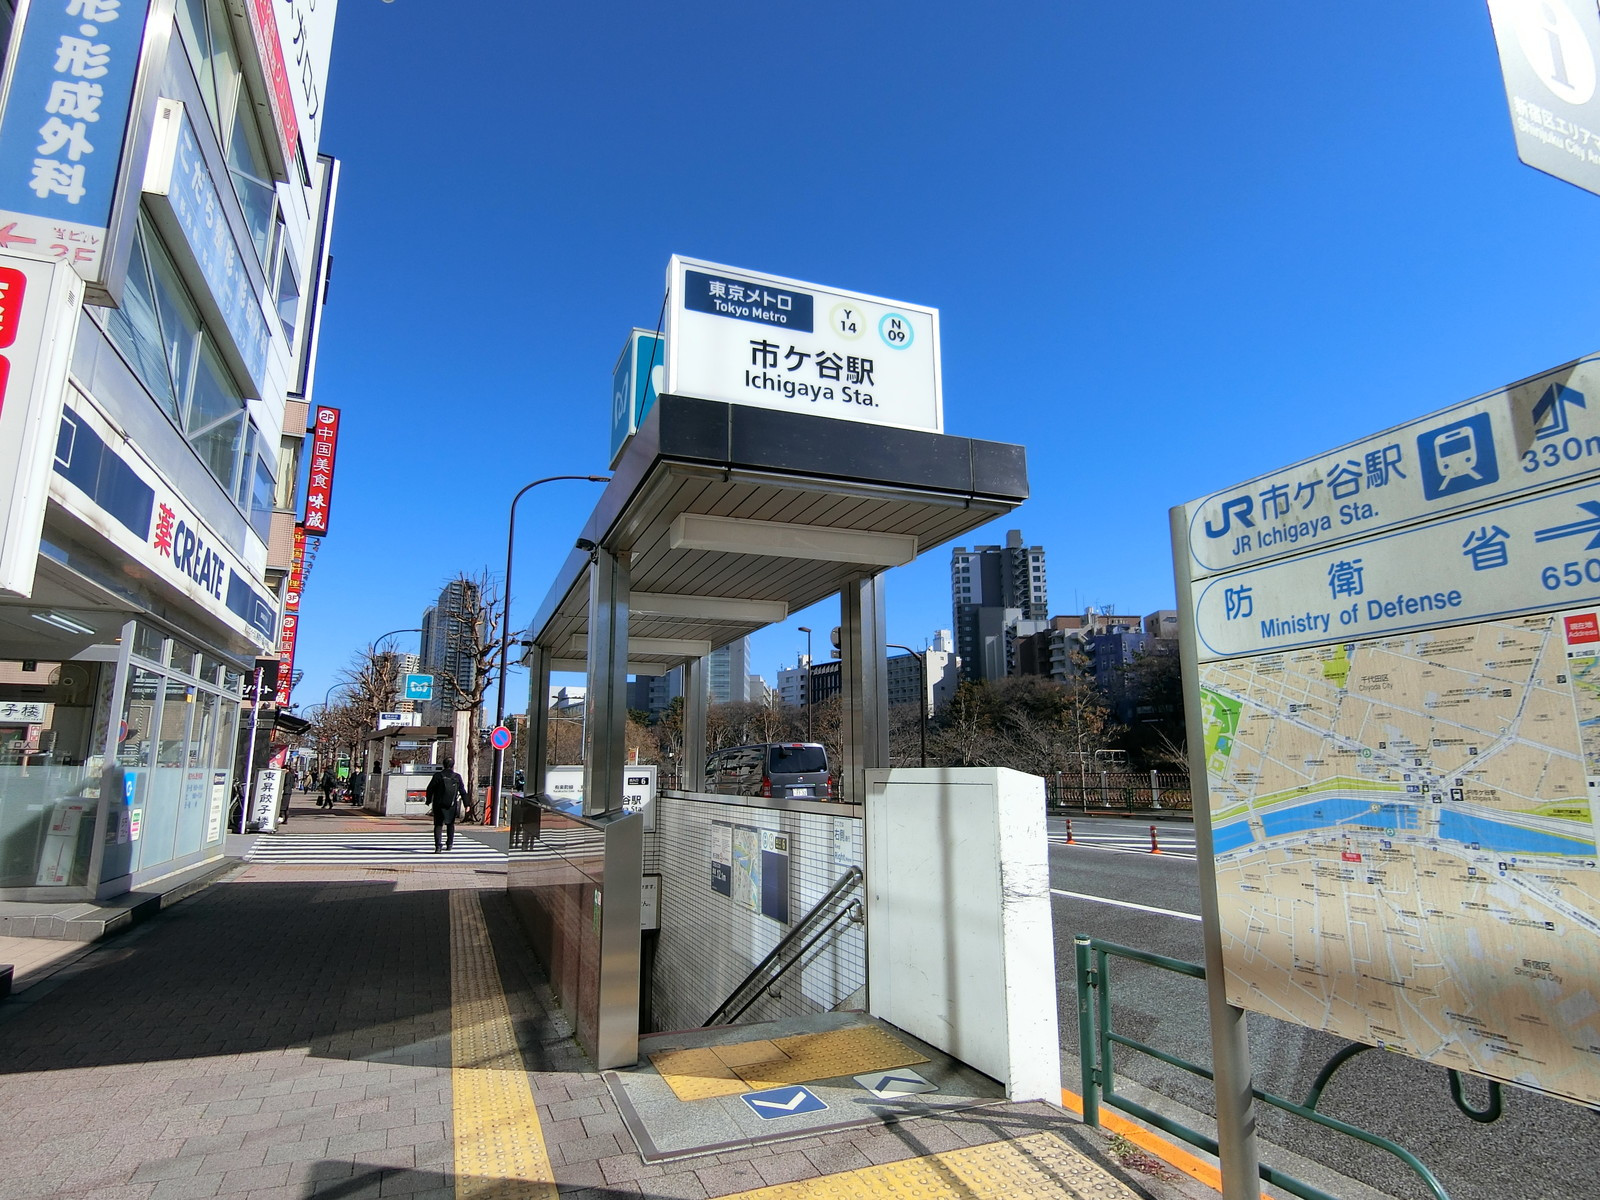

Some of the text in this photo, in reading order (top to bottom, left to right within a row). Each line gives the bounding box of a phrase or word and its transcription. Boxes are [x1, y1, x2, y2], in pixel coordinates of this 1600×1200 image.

[1565, 137, 1586, 162] City
[1587, 148, 1600, 166] Ar
[708, 280, 792, 311] 東京メトロ
[713, 299, 787, 324] Tokyo Metro
[843, 309, 852, 320] Y
[840, 320, 857, 334] 14
[891, 318, 901, 330] N
[887, 330, 906, 343] 09
[745, 369, 880, 408] Ichigaya Sta.
[320, 412, 334, 421] 2F
[1232, 502, 1380, 556] JR Ichigaya Sta.
[153, 501, 226, 601] 薬 CREATE
[1260, 589, 1463, 639] Ministry of Defense
[1382, 682, 1393, 690] City
[641, 777, 646, 785] 6
[1548, 972, 1563, 985] City
